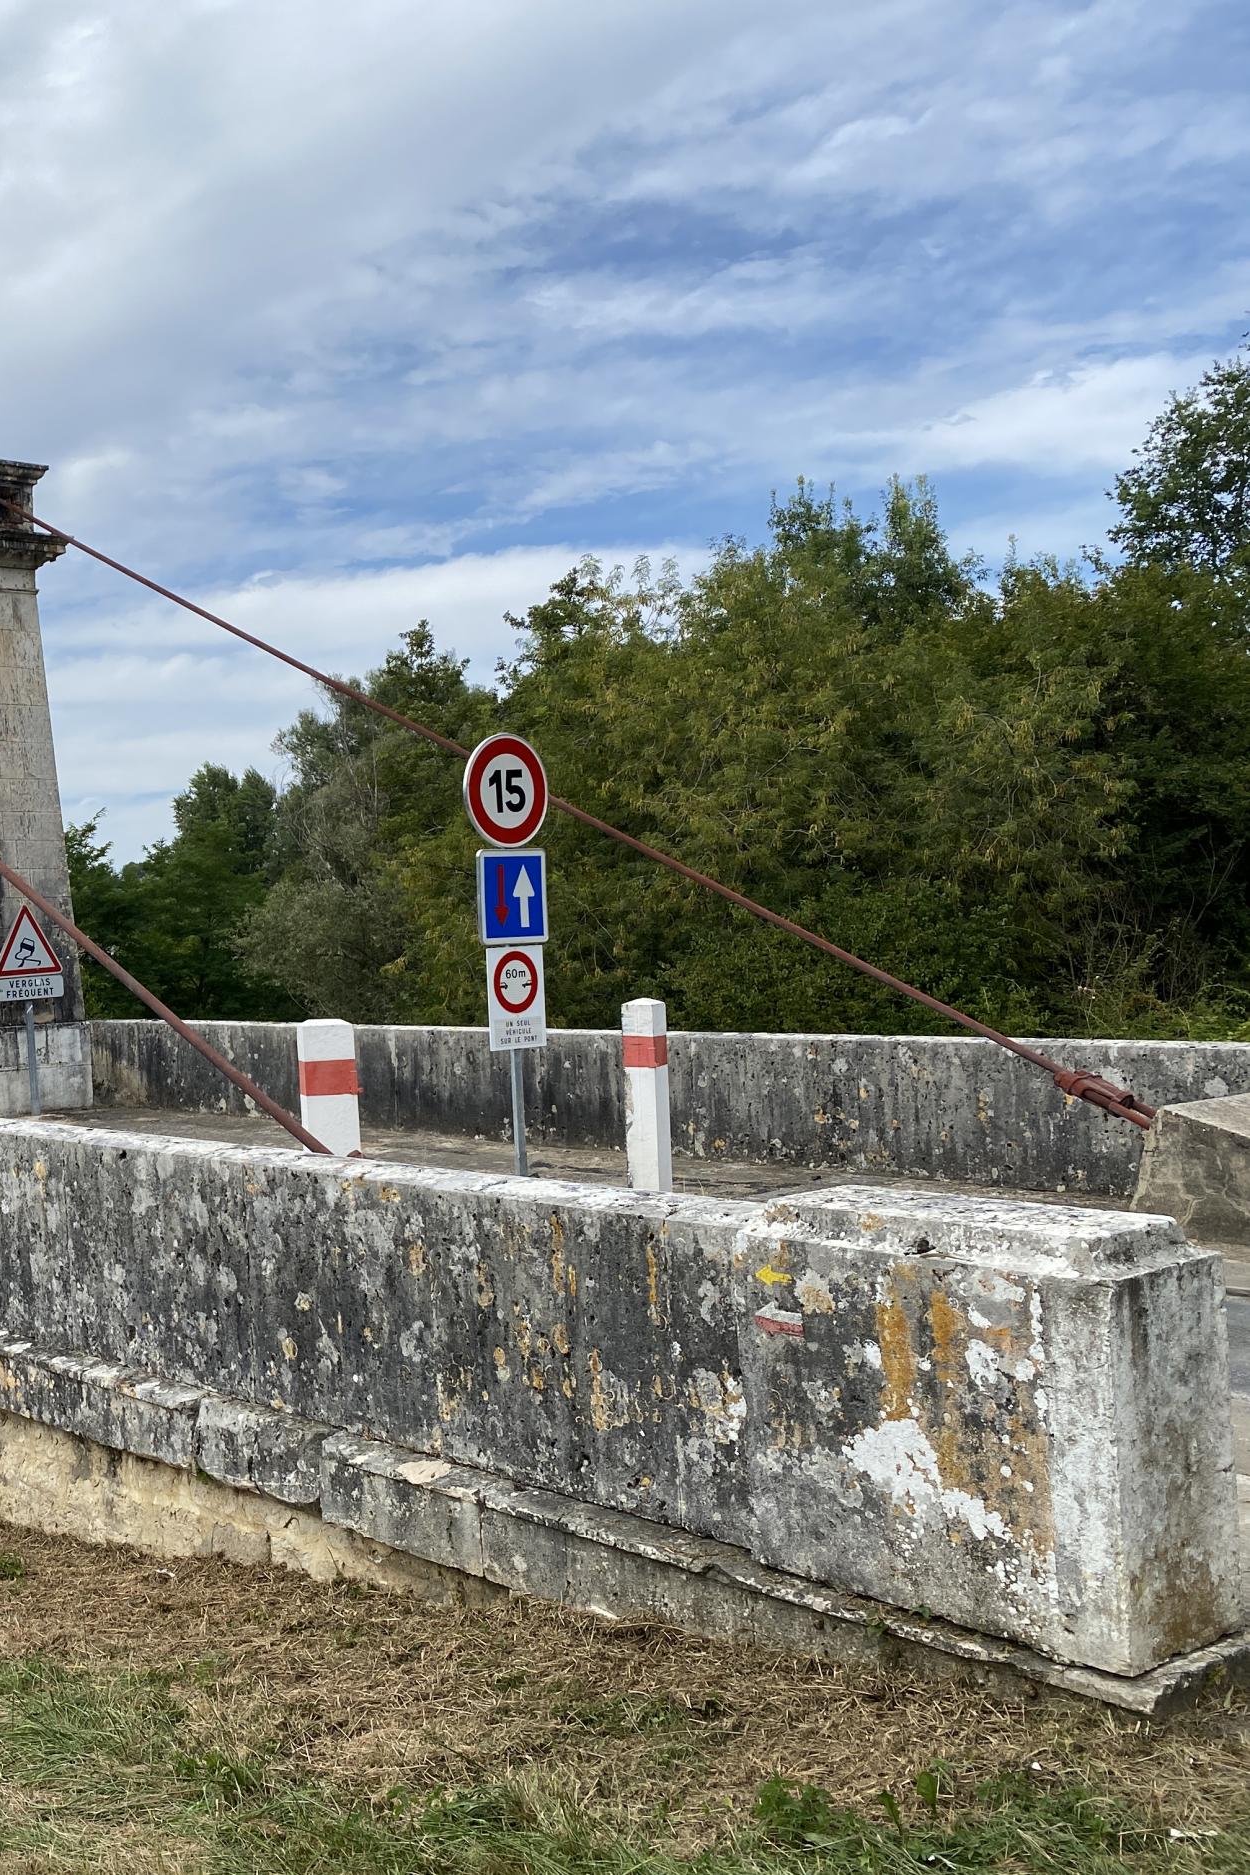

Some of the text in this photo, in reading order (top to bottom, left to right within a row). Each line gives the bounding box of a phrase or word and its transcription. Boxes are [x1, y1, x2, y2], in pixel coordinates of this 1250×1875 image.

[488, 769, 526, 814] 15
[505, 968, 526, 979] 60m
[9, 978, 51, 988] VERGLAS
[6, 987, 54, 998] FRÉQUENT
[516, 1019, 531, 1027] SEUL
[500, 1037, 512, 1045] SUR
